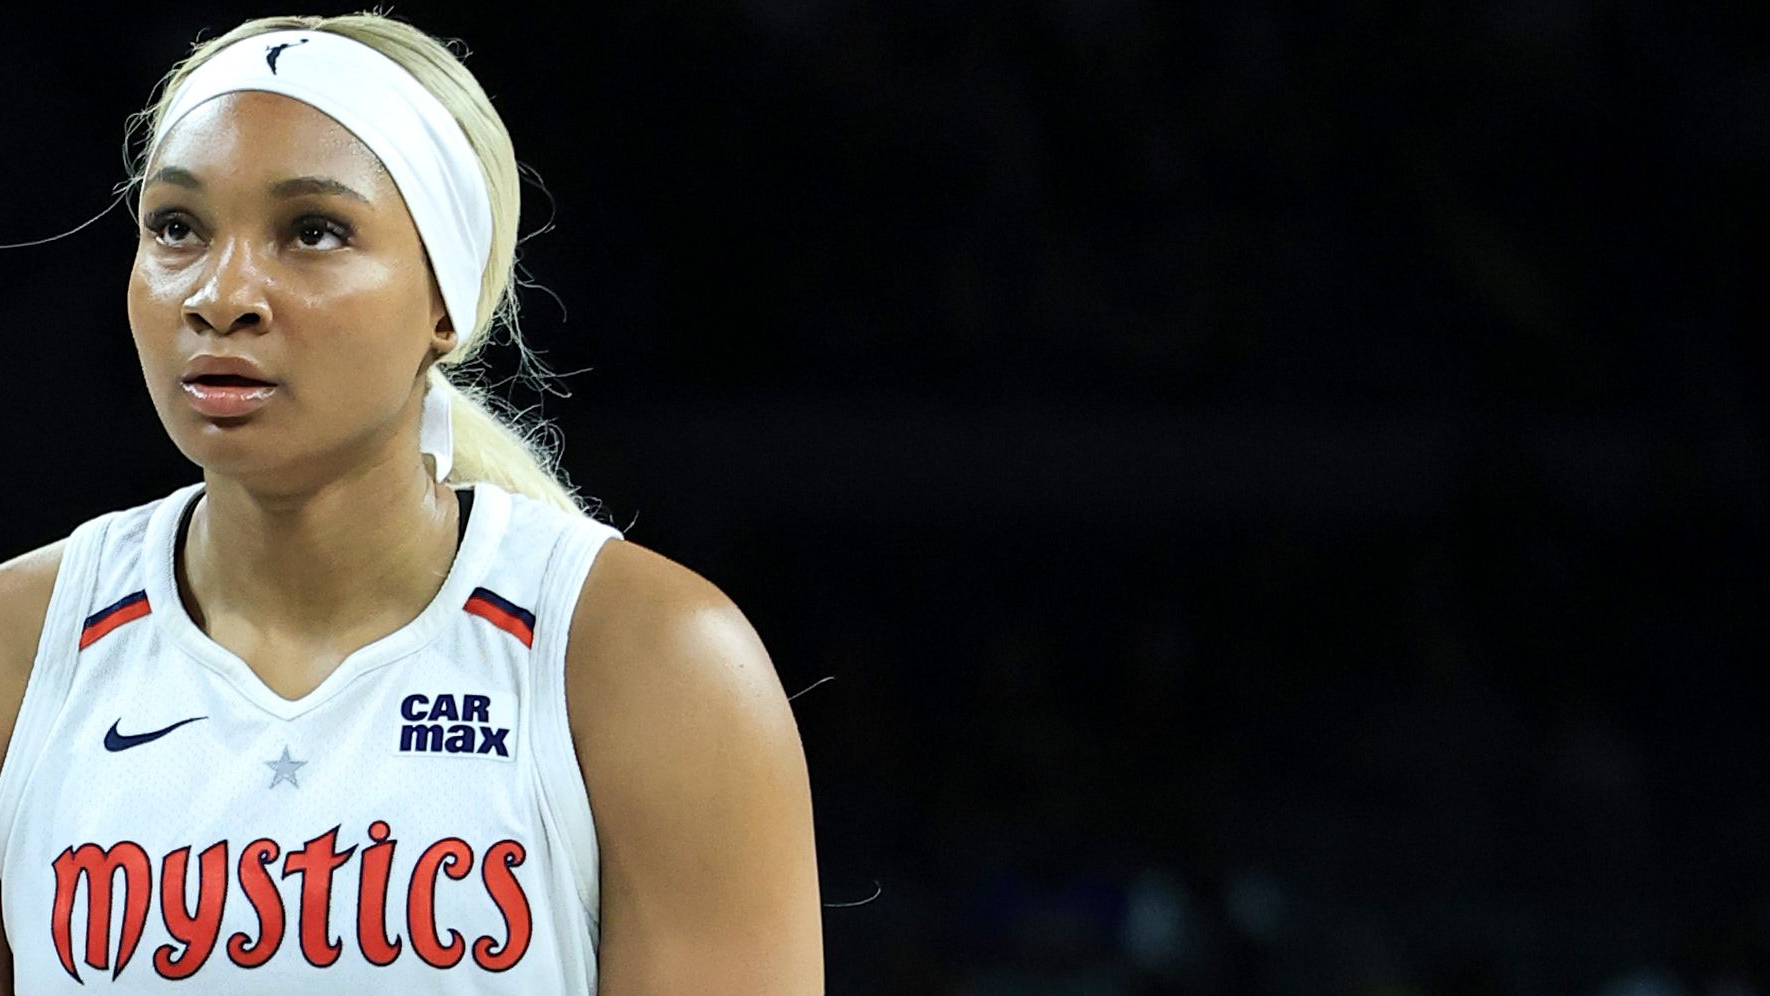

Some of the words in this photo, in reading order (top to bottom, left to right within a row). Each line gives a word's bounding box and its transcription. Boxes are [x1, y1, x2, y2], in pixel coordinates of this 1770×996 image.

[401, 693, 491, 723] CAR
[399, 724, 510, 757] max
[51, 820, 533, 985] mystics
